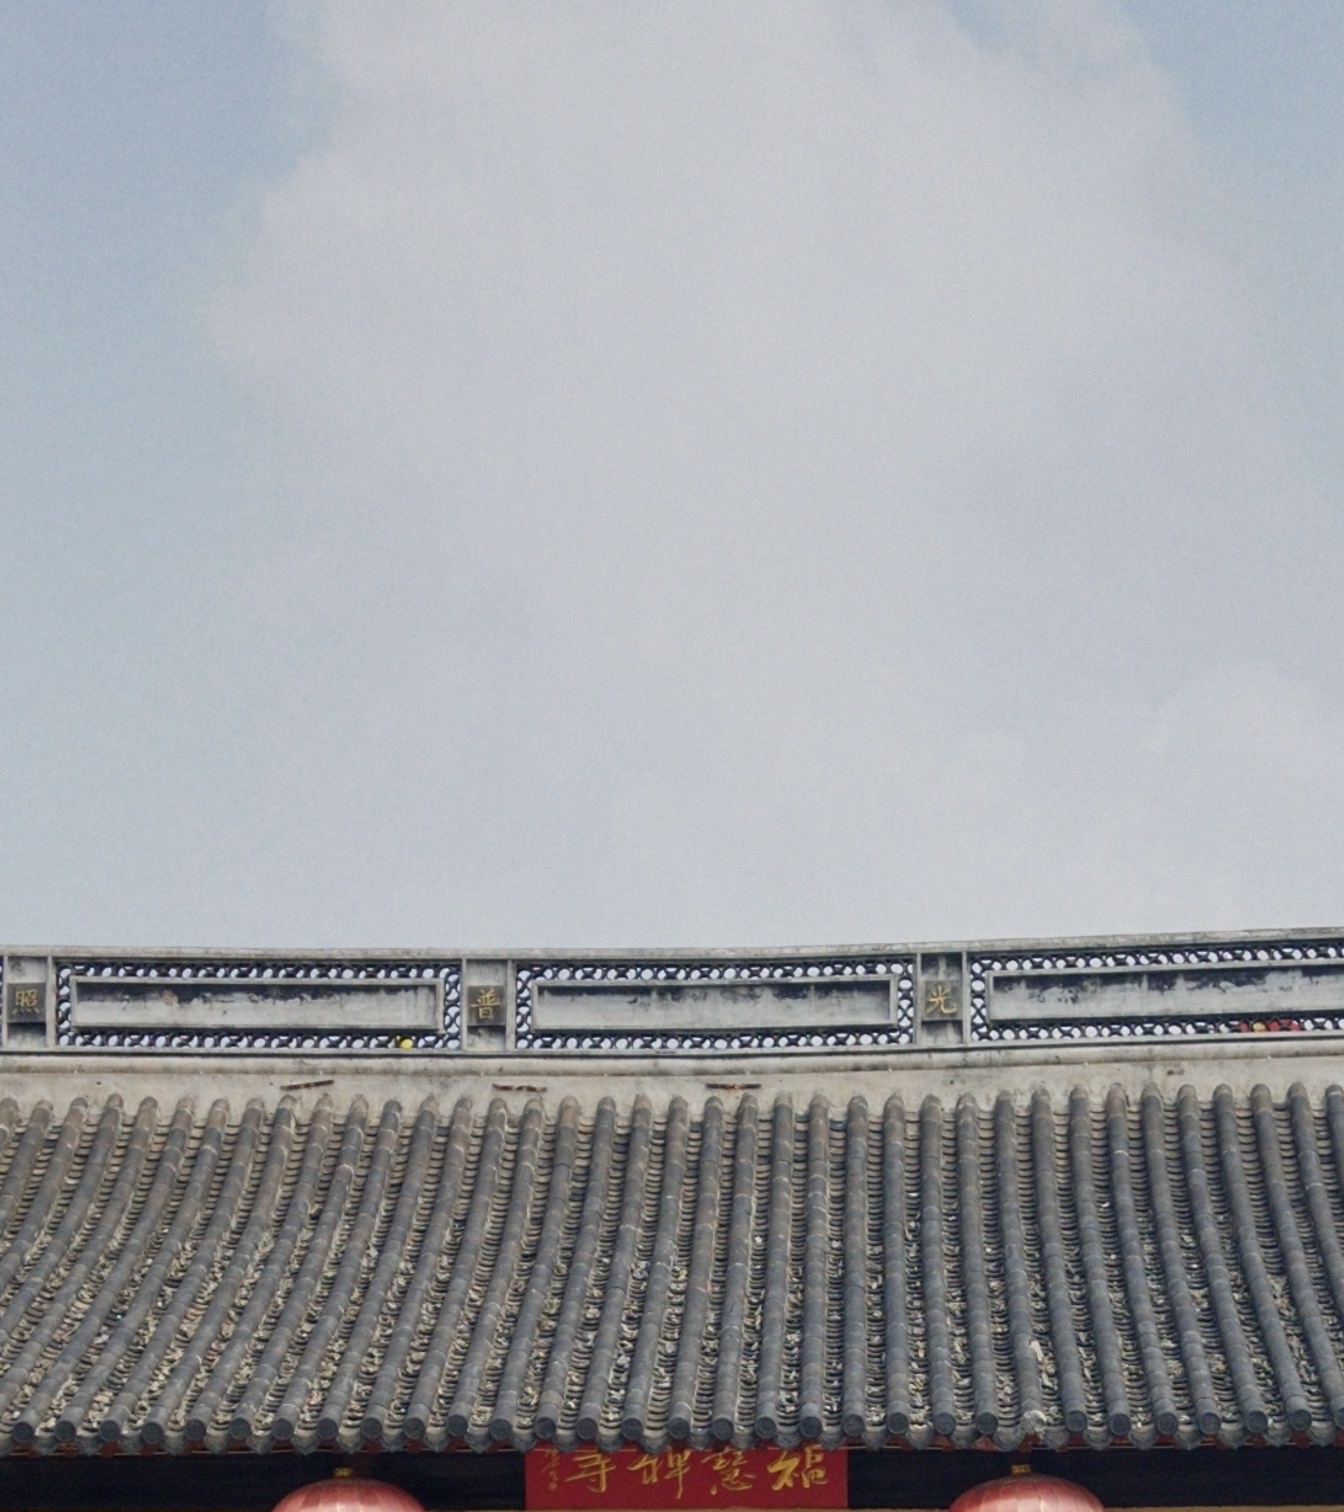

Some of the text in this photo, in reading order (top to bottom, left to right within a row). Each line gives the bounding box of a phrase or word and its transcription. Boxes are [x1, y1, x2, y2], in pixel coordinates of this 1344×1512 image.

[12, 989, 41, 1015] 照
[470, 988, 503, 1020] 普
[925, 985, 958, 1015] 光
